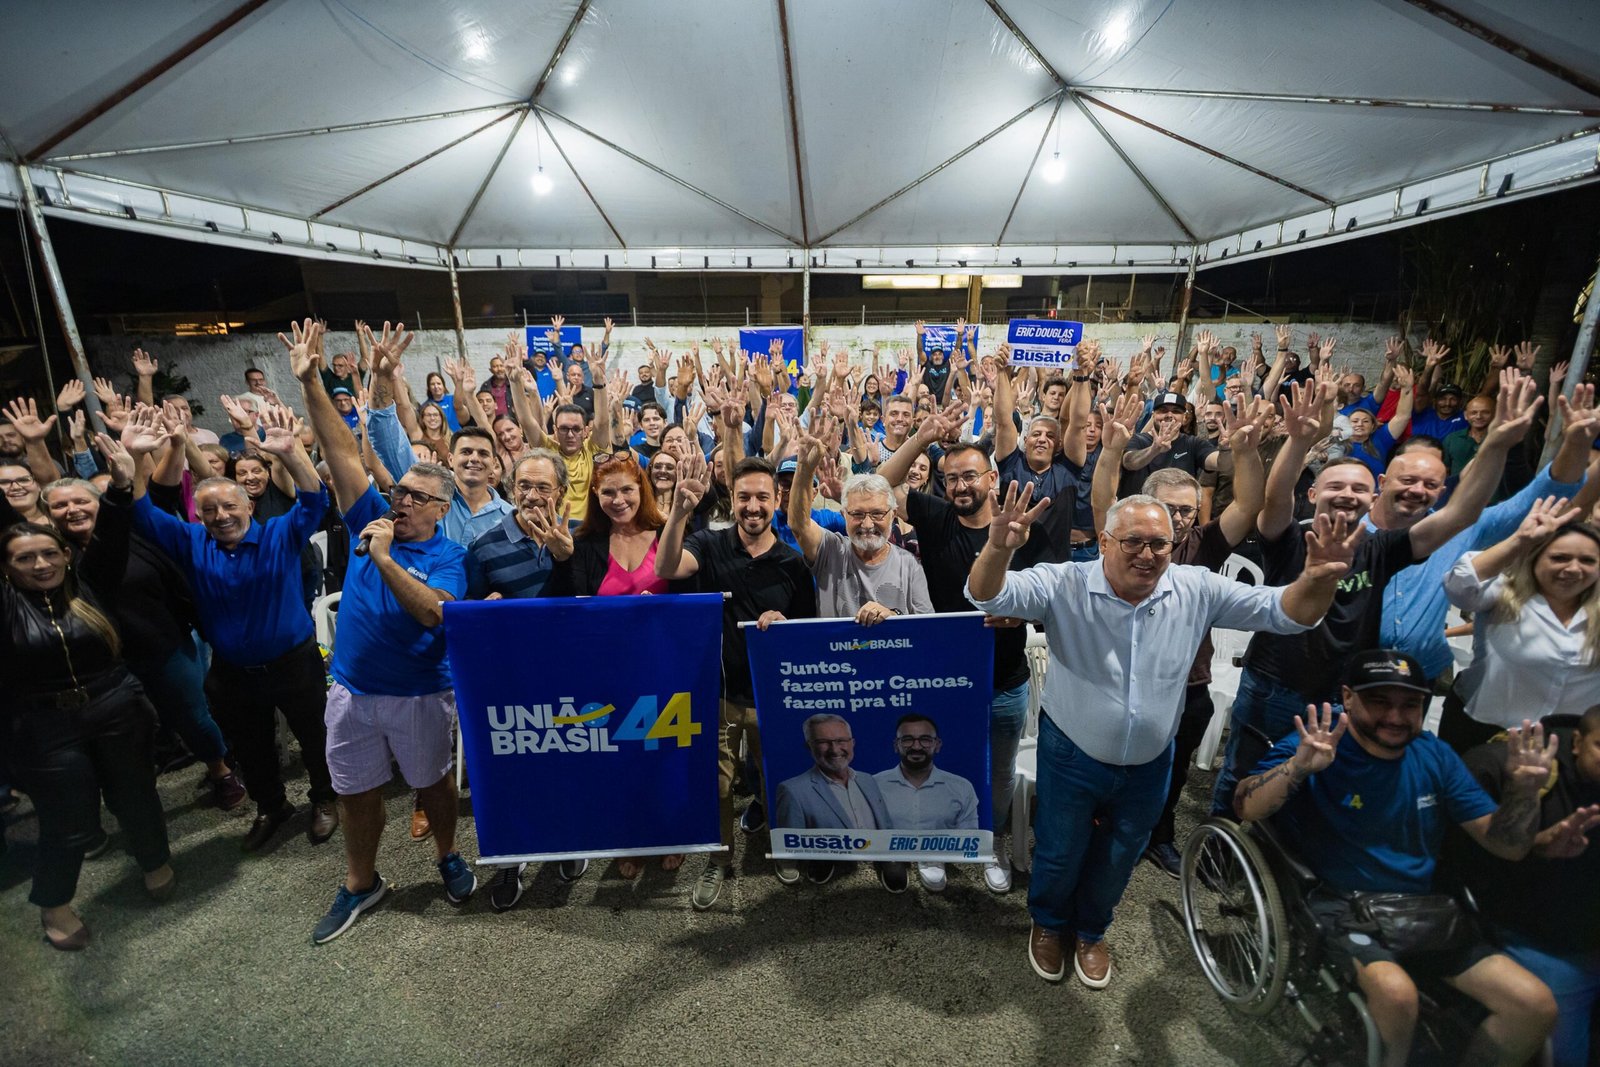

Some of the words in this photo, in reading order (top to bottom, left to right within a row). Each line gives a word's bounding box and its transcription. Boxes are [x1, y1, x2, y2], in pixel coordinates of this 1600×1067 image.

[1015, 327, 1035, 337] ERIC
[1035, 328, 1075, 339] DOUGLAS
[1013, 349, 1072, 363] Busato
[870, 638, 913, 649] BRASIL
[780, 661, 857, 675] Juntos,
[781, 679, 844, 692] fazem
[849, 679, 884, 695] por
[889, 675, 974, 690] Canoas,
[783, 696, 845, 709] fazem
[849, 696, 886, 712] pra
[890, 693, 912, 706] ti!
[611, 692, 702, 751] 44
[490, 728, 619, 755] BRASIL
[784, 833, 868, 850] Busato
[889, 837, 918, 850] ERIC
[920, 837, 980, 851] DOUGLAS
